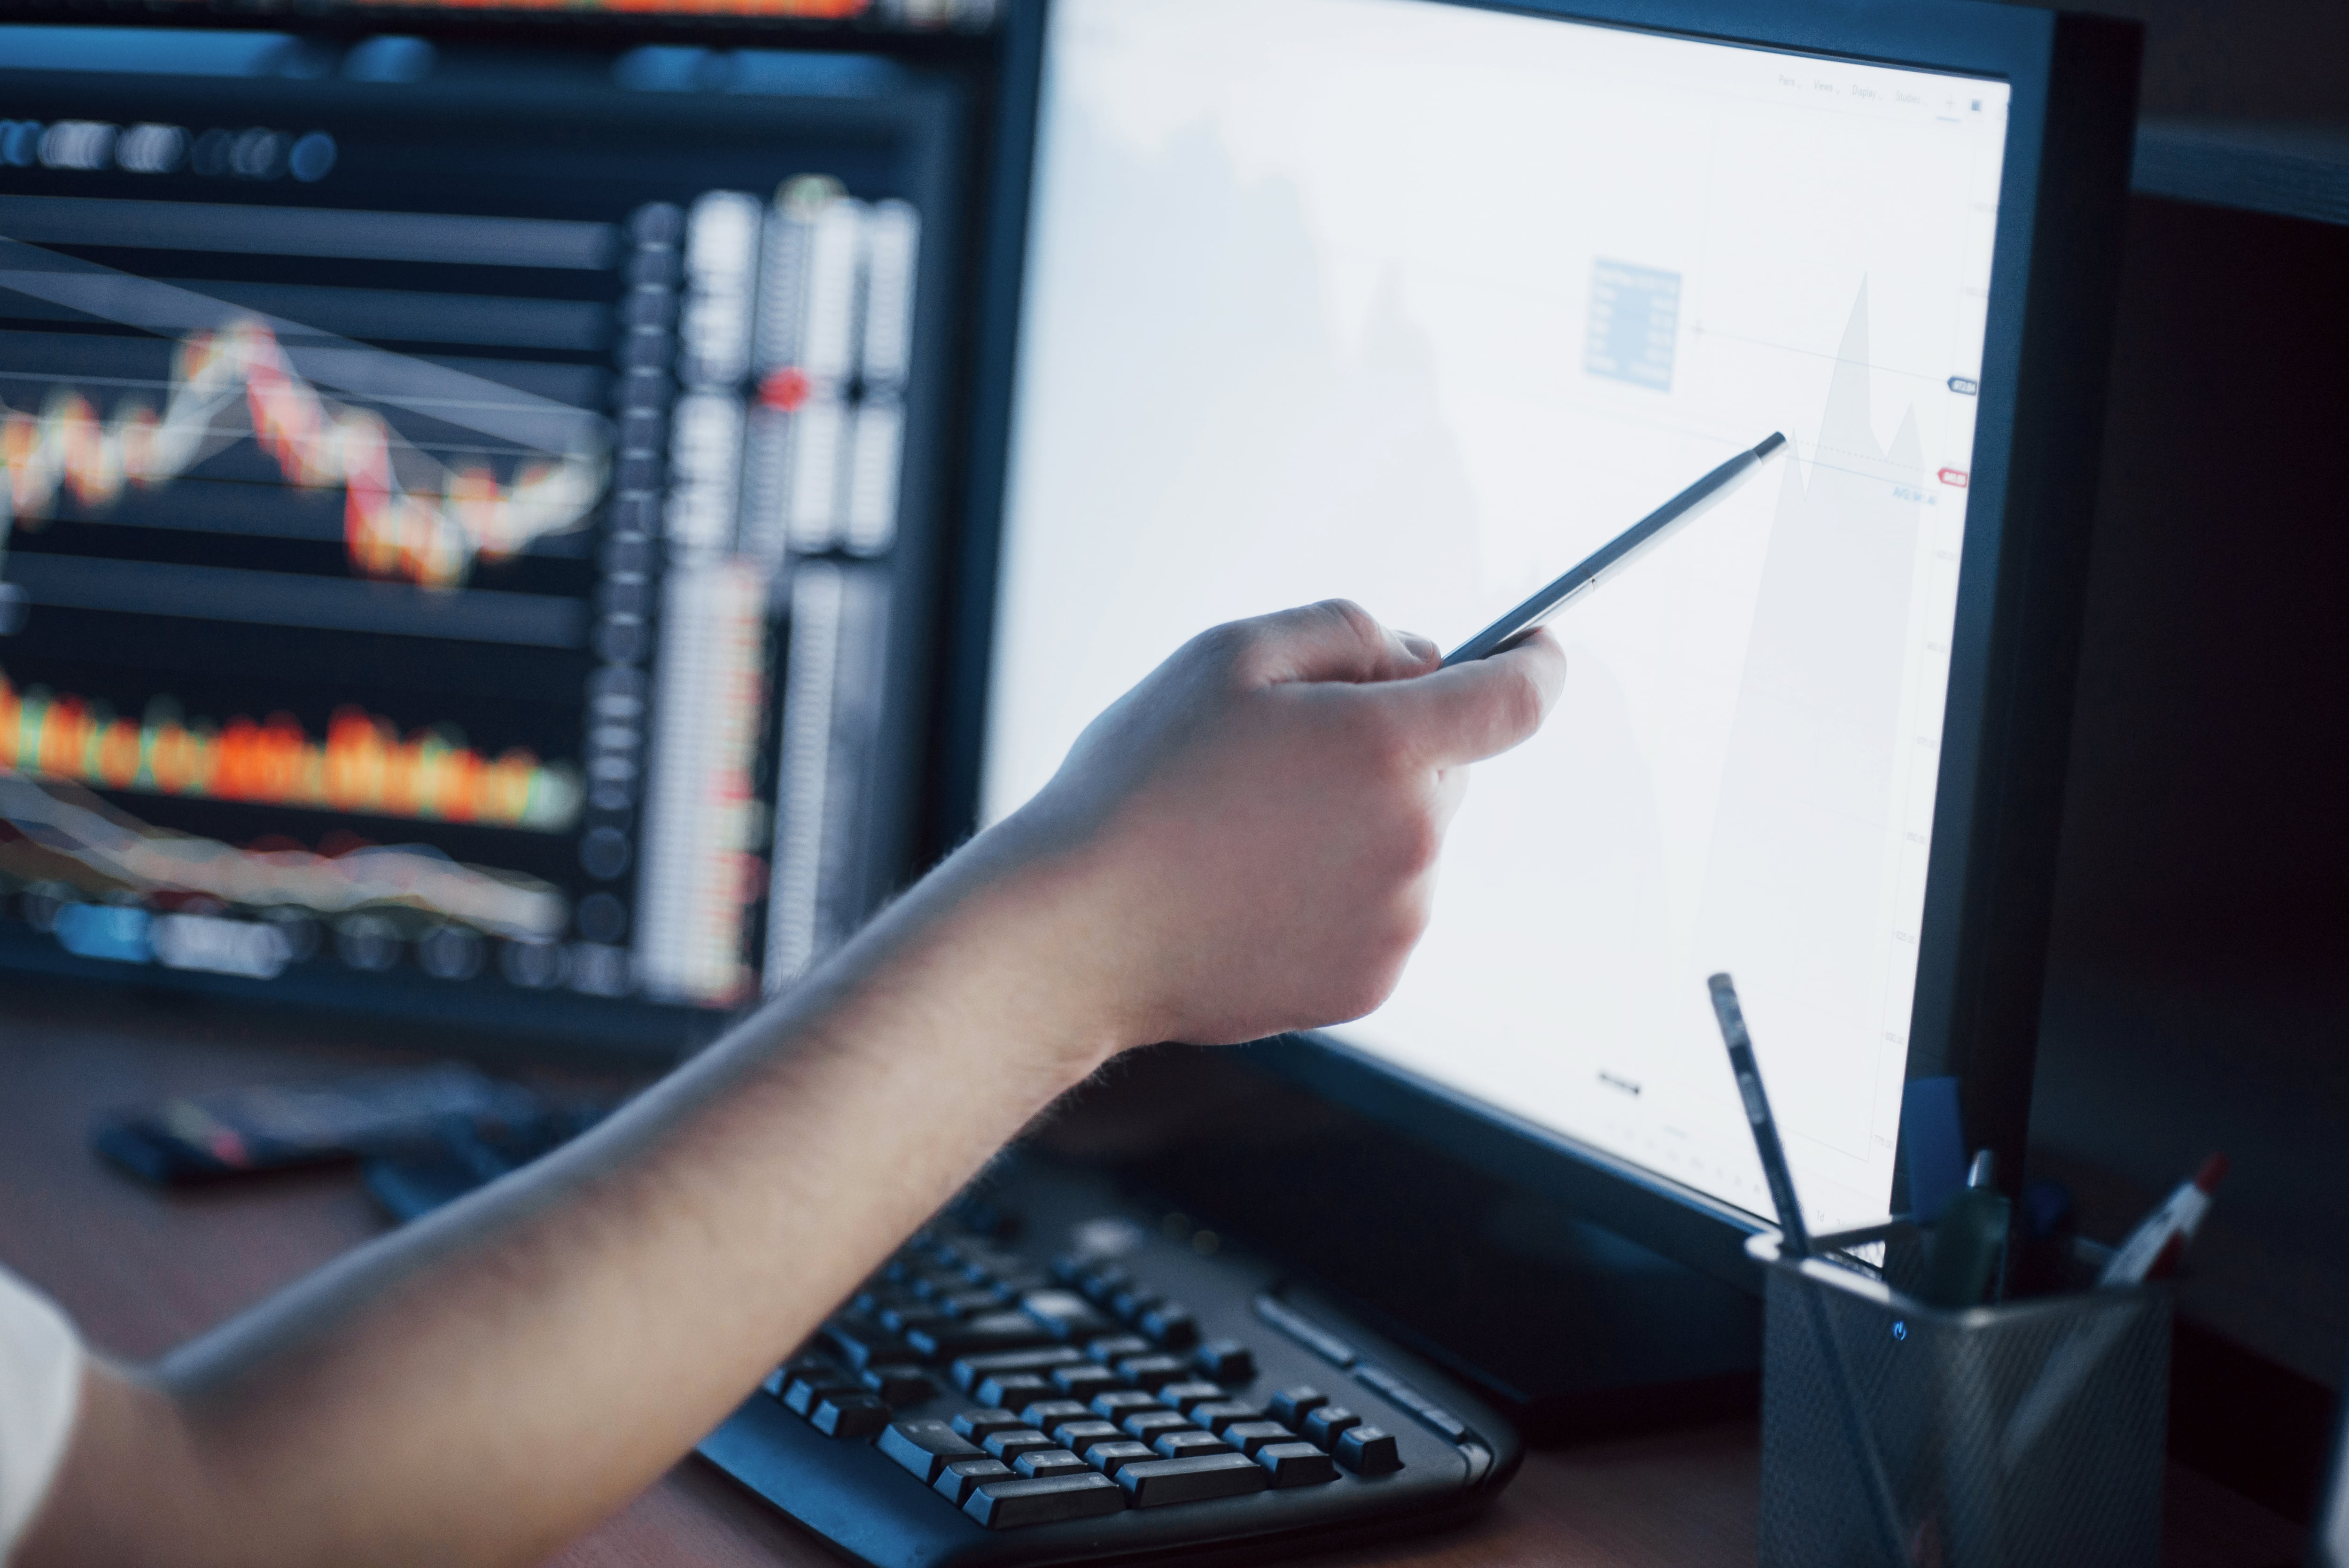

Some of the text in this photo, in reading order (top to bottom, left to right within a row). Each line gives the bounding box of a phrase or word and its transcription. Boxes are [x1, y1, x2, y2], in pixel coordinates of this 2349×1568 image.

[1814, 78, 1833, 93] Views
[1852, 85, 1876, 101] Display
[1895, 90, 1921, 104] Studies
[1917, 736, 1937, 749] 875.00
[1896, 931, 1916, 945] 825.00
[1885, 1032, 1906, 1046] 800.00
[1874, 1134, 1894, 1149] 775.00
[1817, 1210, 1825, 1222] 1d
